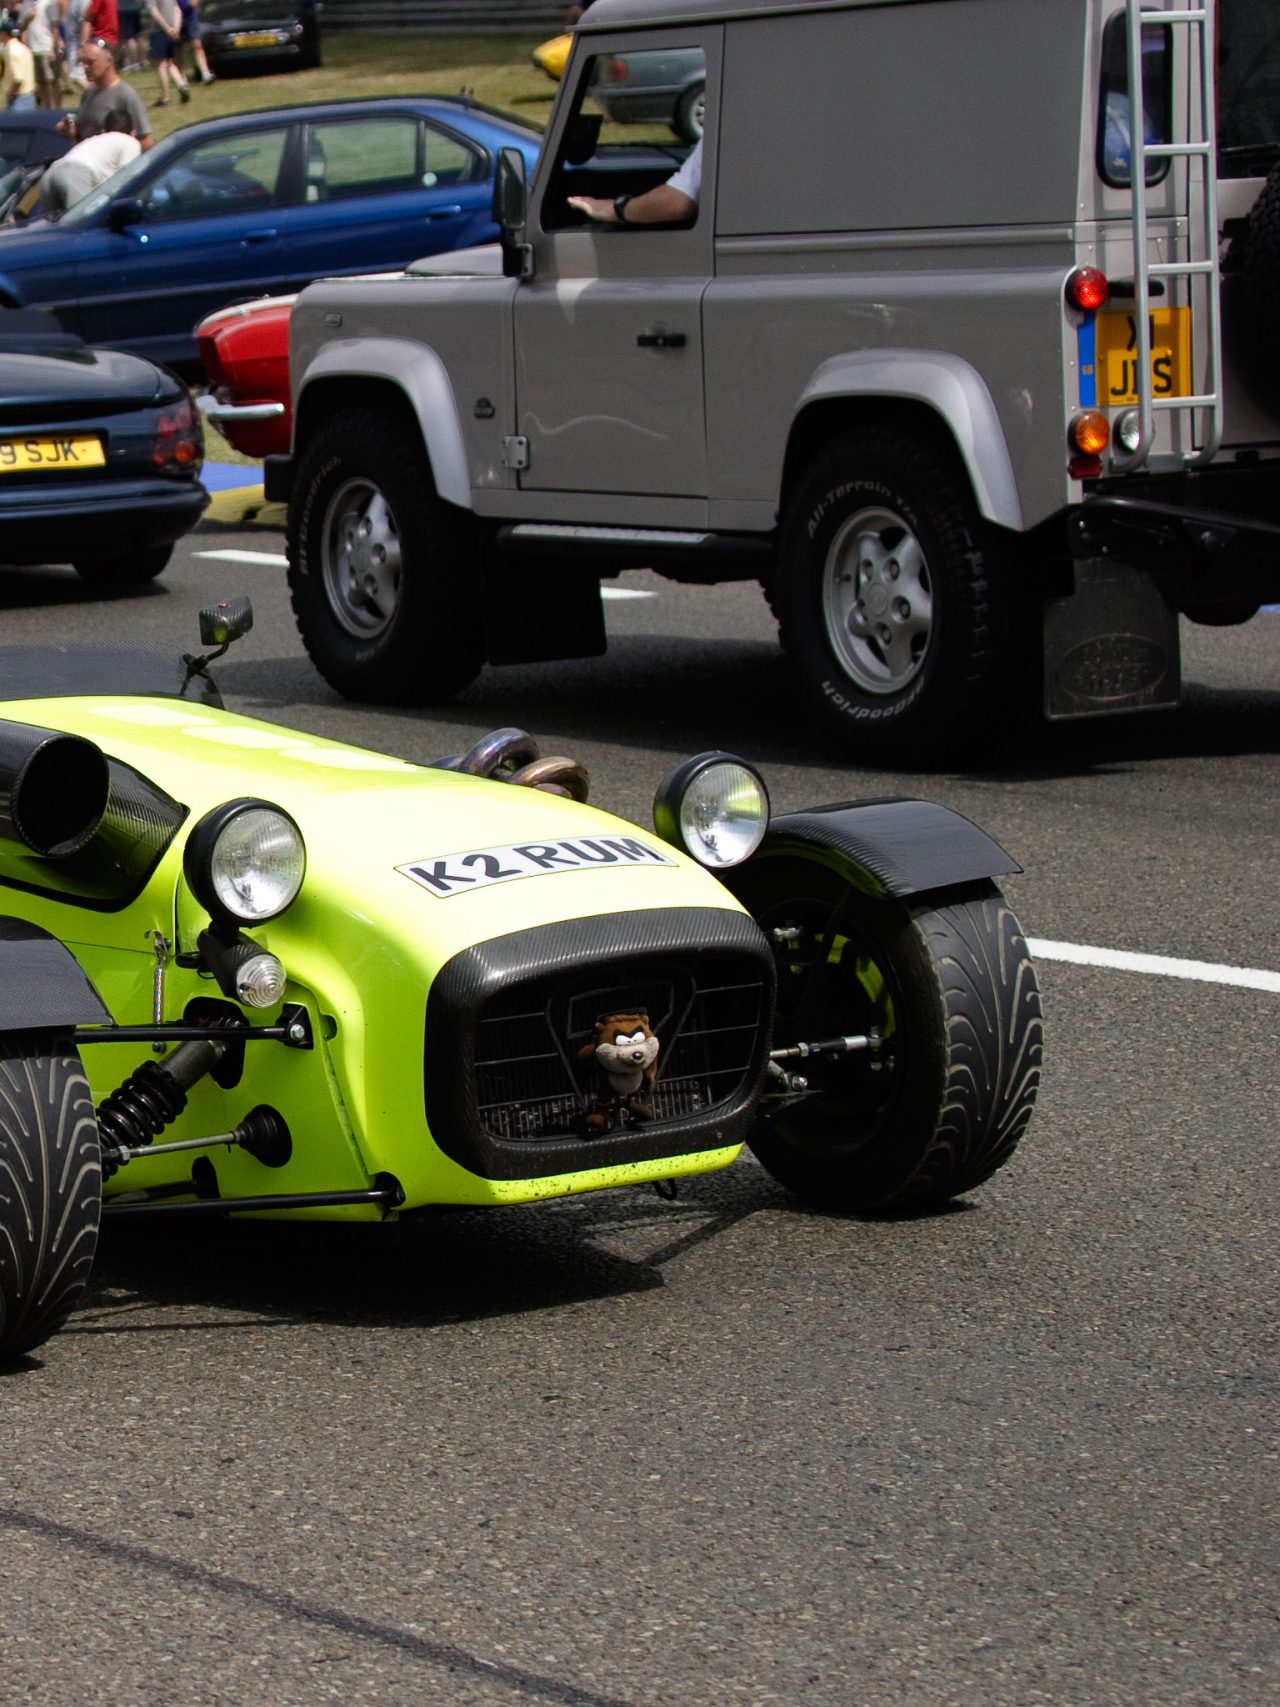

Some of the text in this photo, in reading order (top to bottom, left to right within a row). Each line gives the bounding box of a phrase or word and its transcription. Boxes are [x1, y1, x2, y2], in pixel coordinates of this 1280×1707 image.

[24, 438, 80, 463] SJK
[409, 837, 666, 892] K2 RUM
